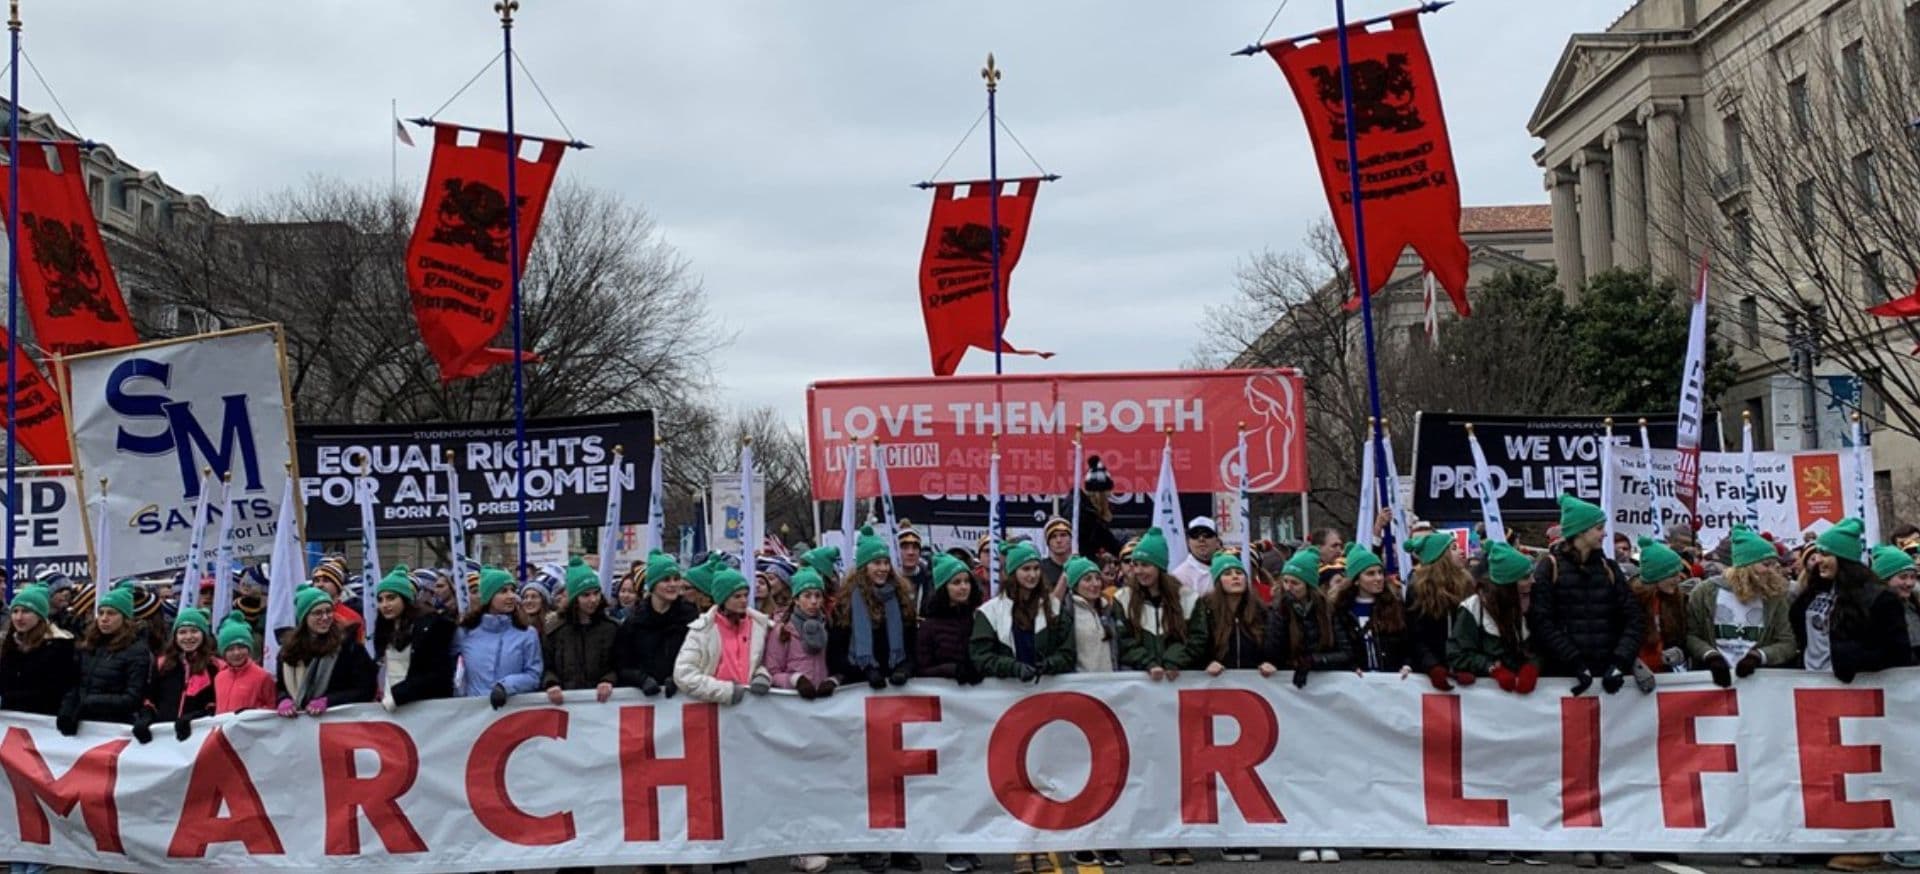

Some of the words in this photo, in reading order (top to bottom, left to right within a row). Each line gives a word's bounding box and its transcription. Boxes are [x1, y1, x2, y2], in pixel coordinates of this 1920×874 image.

[106, 358, 265, 500] SM
[822, 404, 934, 439] LOVE
[948, 401, 1066, 435] THEM
[1082, 398, 1204, 433] BOTH
[413, 428, 517, 440] STUDENTSFORLIFE.OR
[1504, 435, 1550, 461] WE
[317, 444, 450, 475] EQUAL
[467, 435, 606, 470] RIGHTS
[876, 443, 938, 467] CTION
[1008, 448, 1055, 470] THE
[1067, 450, 1192, 470] PO-LIE
[1705, 464, 1719, 473] for
[1720, 464, 1733, 473] the
[1735, 465, 1773, 473] Dnse
[1776, 464, 1786, 473] of
[300, 477, 381, 506] FOR
[393, 474, 471, 503] ALL
[484, 462, 636, 499] WOMEN
[920, 472, 1158, 504] GENERAON
[1430, 465, 1600, 498] PRO-LIFE
[1620, 475, 1710, 503] Traitn,
[384, 505, 432, 519] BORN
[436, 503, 473, 518] AD
[1616, 507, 1653, 525] and
[1661, 507, 1747, 529] Proerty
[0, 703, 724, 858] MARCH
[864, 688, 1288, 832] FOR
[1421, 688, 1896, 829] LIFE
